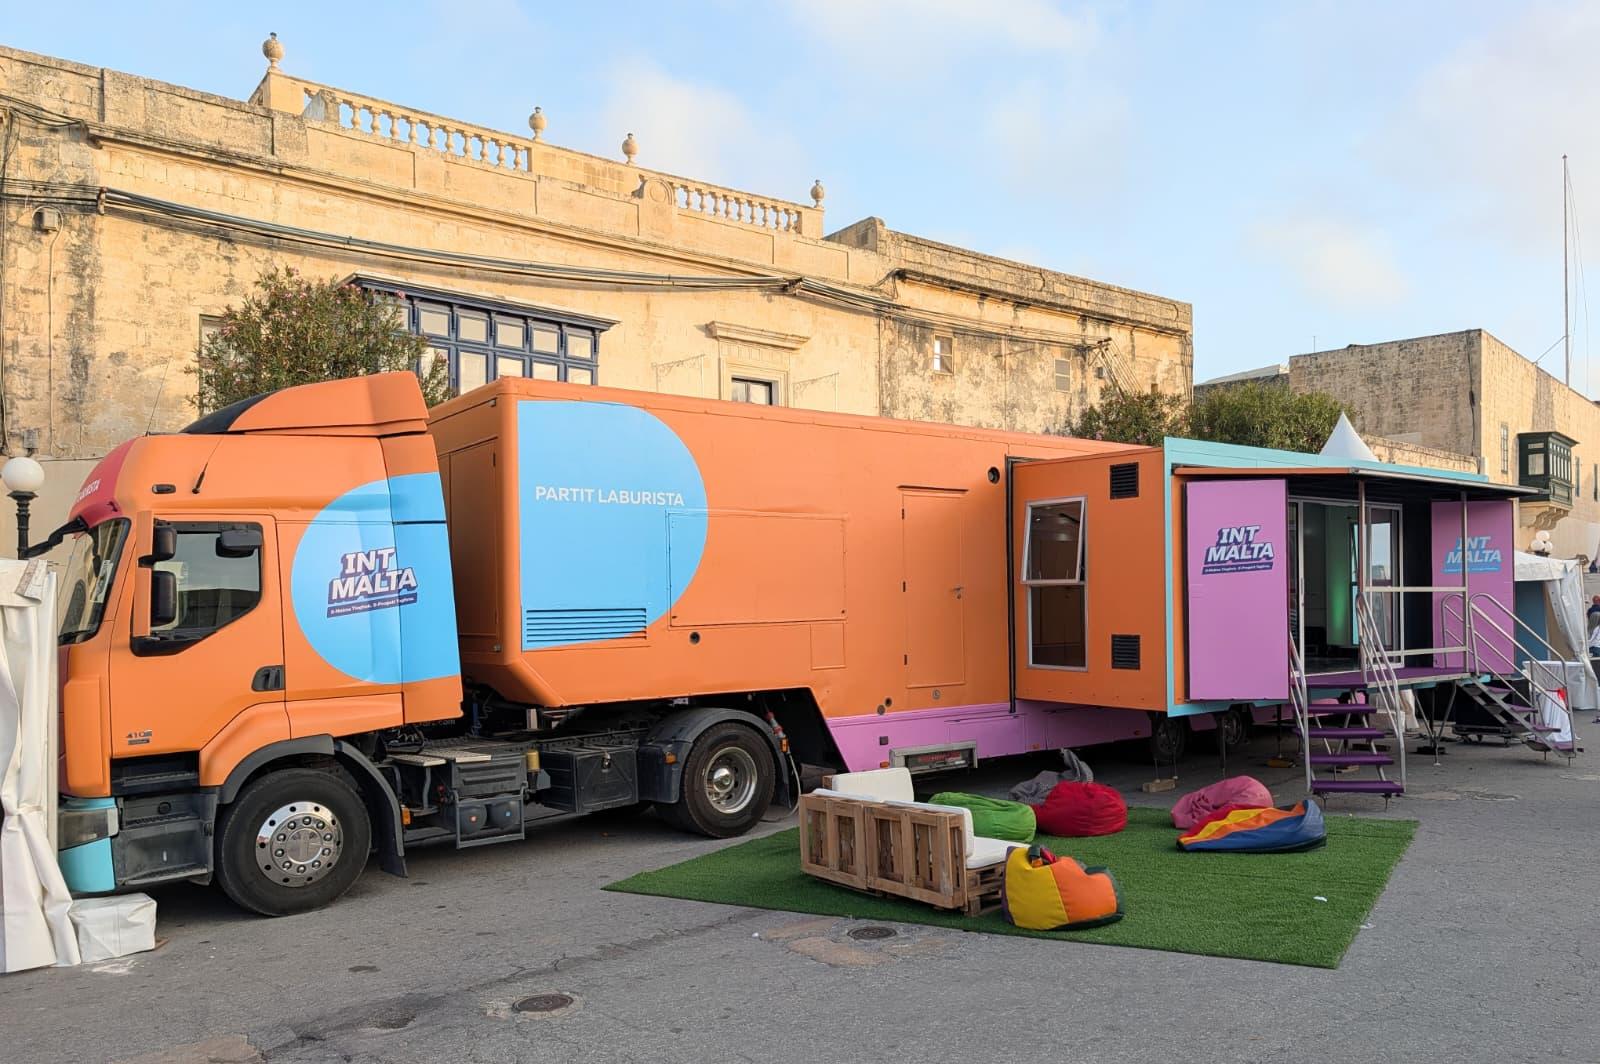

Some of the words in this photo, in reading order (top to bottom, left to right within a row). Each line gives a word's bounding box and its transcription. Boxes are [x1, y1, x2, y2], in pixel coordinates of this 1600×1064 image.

[535, 486, 595, 502] PARTIT
[598, 490, 685, 506] LABURISTA
[1218, 525, 1260, 544] INT
[343, 547, 396, 576] INT
[1206, 542, 1274, 563] MALTA
[330, 567, 418, 602] MALTA
